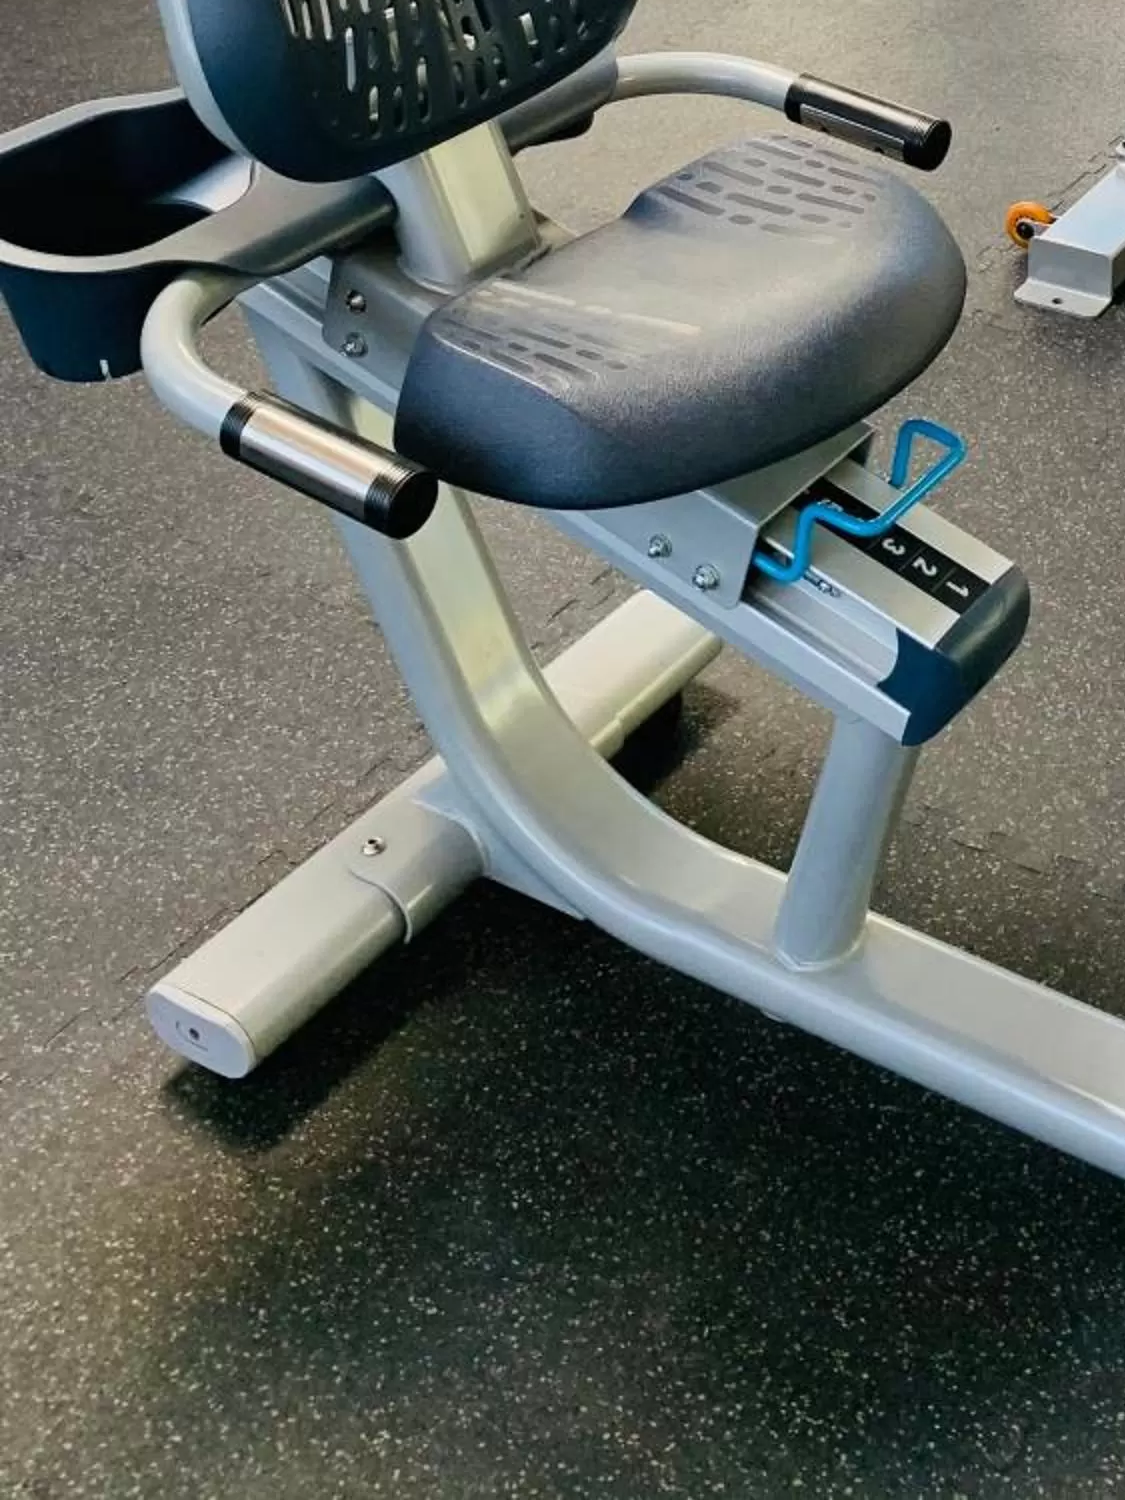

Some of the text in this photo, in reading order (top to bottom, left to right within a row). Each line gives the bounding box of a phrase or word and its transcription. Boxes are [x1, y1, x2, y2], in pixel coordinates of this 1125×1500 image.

[881, 538, 906, 556] 3
[912, 556, 938, 576] 2
[946, 581, 970, 597] 1
